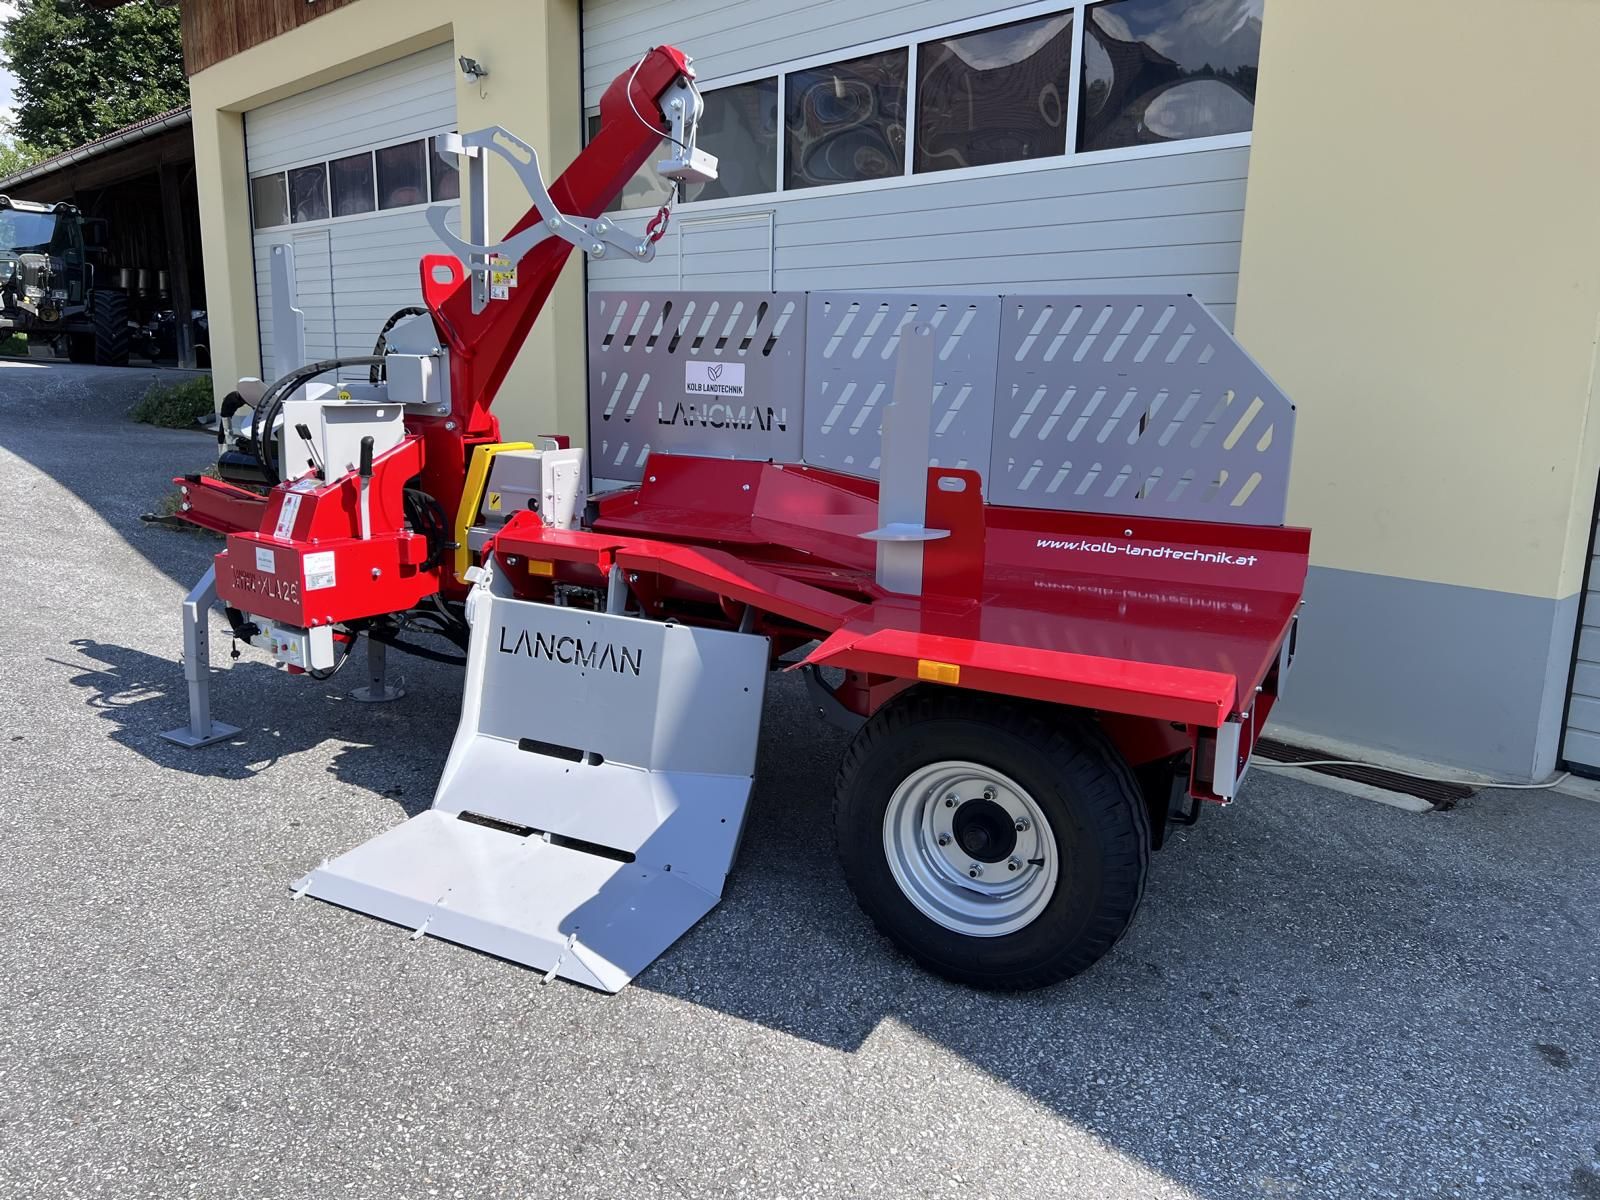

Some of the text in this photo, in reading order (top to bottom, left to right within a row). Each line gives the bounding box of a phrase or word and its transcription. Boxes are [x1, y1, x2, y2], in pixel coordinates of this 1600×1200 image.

[687, 383, 743, 394] KOLB LANDTECHNIK
[658, 401, 787, 431] LANCMAN
[1036, 538, 1258, 566] www.kolb-landtechnik.at
[499, 626, 643, 676] LANCMAN
